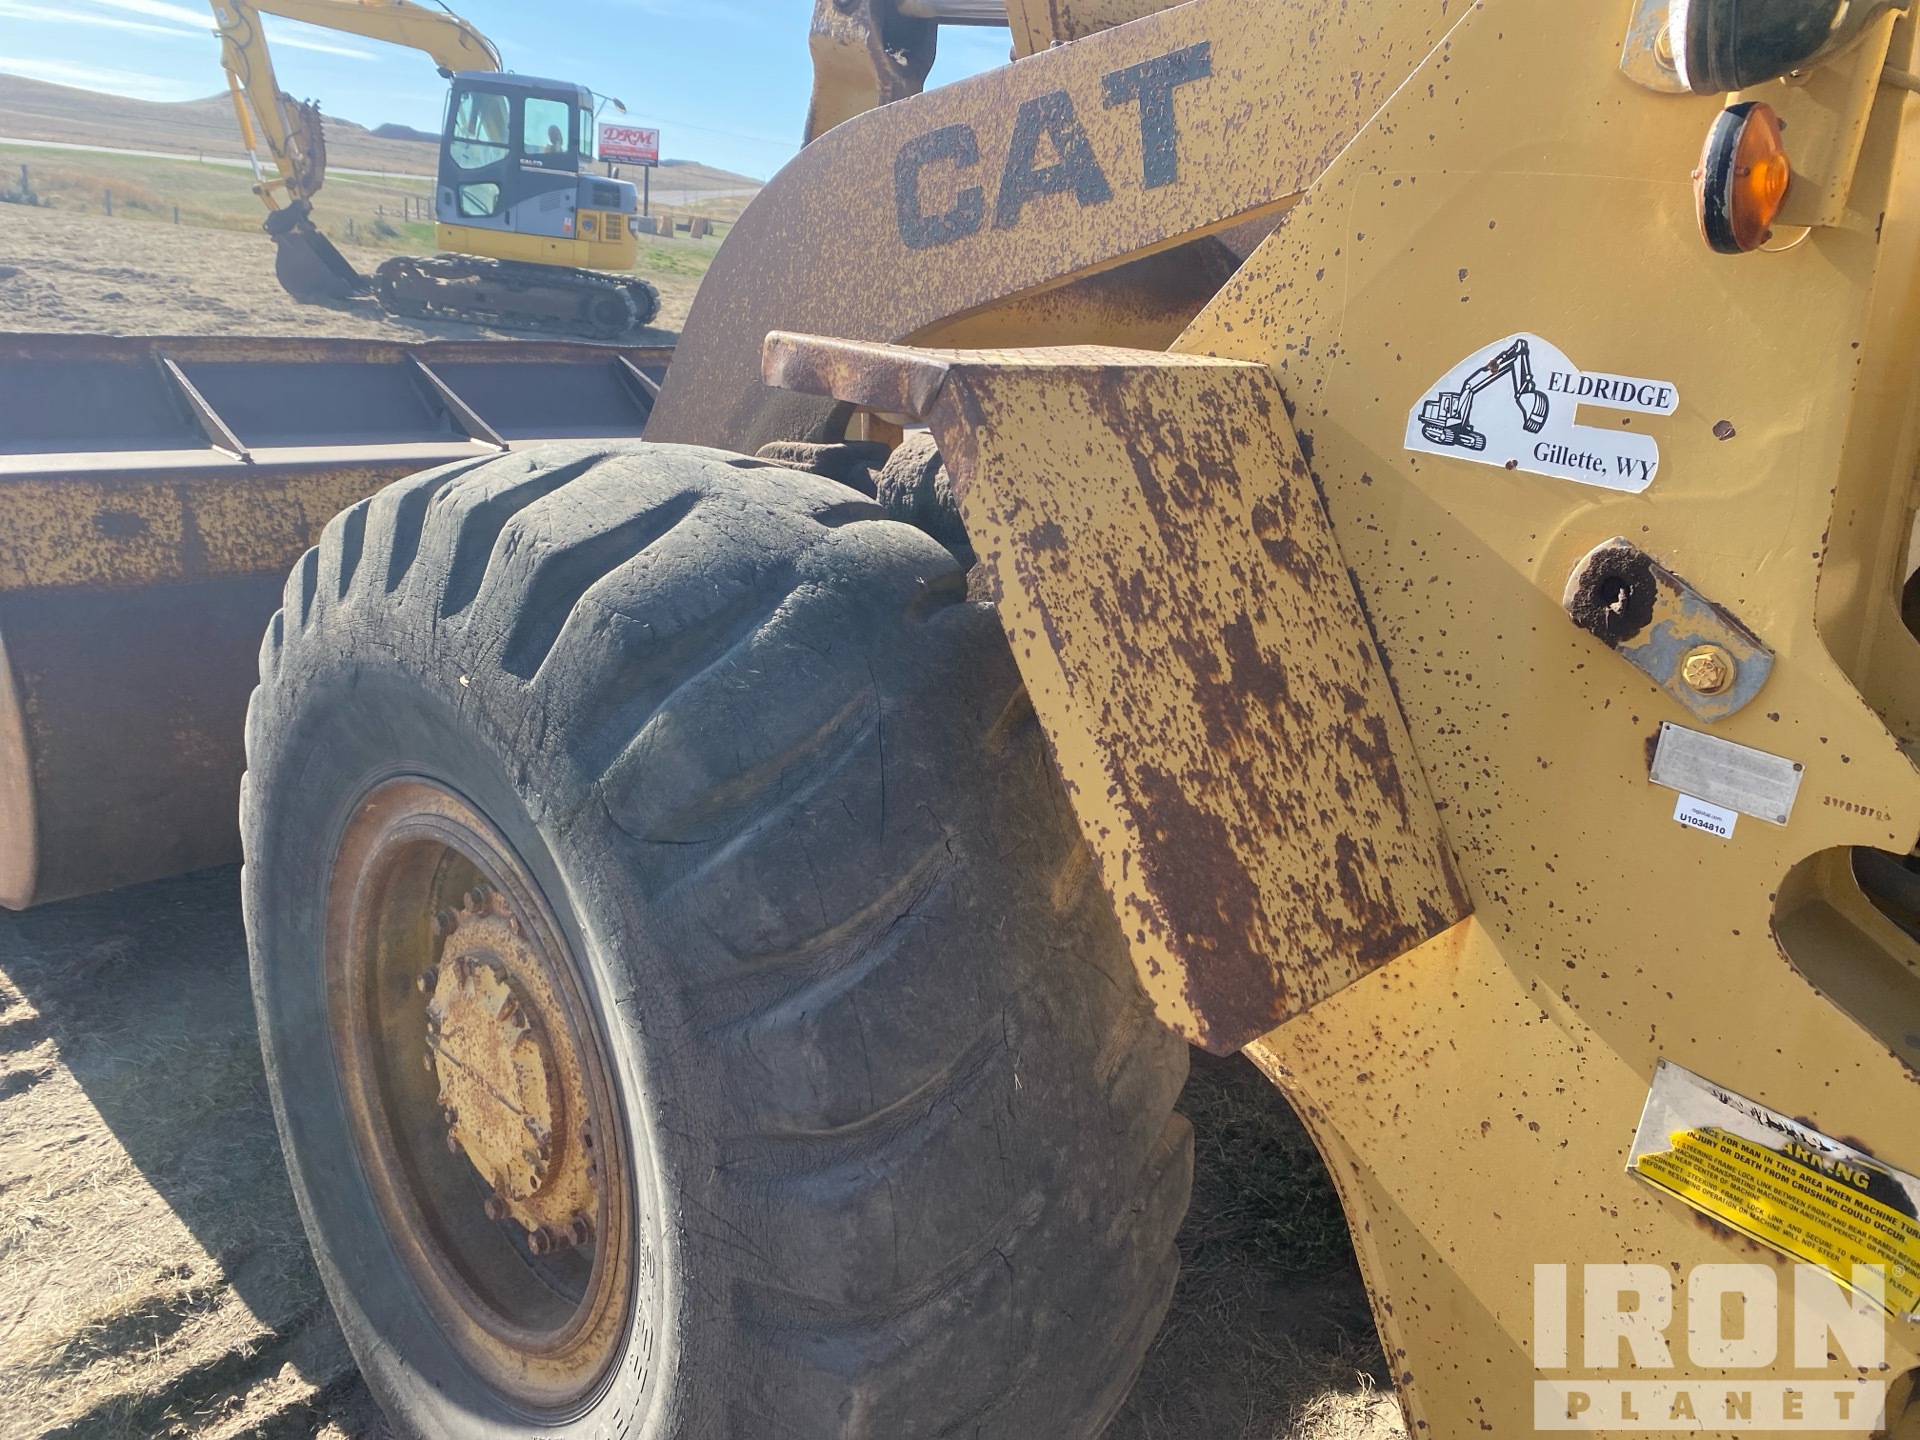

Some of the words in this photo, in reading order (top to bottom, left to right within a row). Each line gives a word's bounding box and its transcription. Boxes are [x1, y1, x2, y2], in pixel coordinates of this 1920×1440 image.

[603, 127, 655, 146] DRM
[894, 39, 1211, 250] CAT
[1547, 371, 1672, 409] ELDRIDGE
[1533, 442, 1607, 477] Gillette,
[1616, 455, 1656, 481] WY
[1680, 813, 1726, 835] U1034810
[1642, 1158, 1665, 1173] BEFORE
[1667, 1169, 1701, 1191] RESUMING
[1702, 1188, 1737, 1210] OPERATION
[1738, 1207, 1748, 1215] OR
[1749, 1212, 1781, 1232] MACHINE
[1783, 1229, 1799, 1242] WILL
[1801, 1238, 1816, 1250] NOT
[1674, 1154, 1692, 1166] NEAR
[1693, 1164, 1719, 1181] CENTER
[1719, 1177, 1728, 1186] OF
[1682, 1142, 1713, 1160] STEERING
[1714, 1157, 1736, 1171] FRAME
[1738, 1169, 1755, 1181] LOCK
[1757, 1179, 1772, 1191] LINK
[1774, 1187, 1806, 1208] BETWEEN
[1808, 1204, 1831, 1219] FRONT
[1831, 1216, 1847, 1228] AND
[1848, 1224, 1867, 1238] REAR
[1868, 1234, 1897, 1255] FRAMES
[1687, 1131, 1718, 1148] INJURY
[1720, 1145, 1732, 1156] OR
[1734, 1151, 1762, 1170] DEATH
[1764, 1166, 1790, 1184] FROM
[1791, 1180, 1838, 1208] CRUSHING
[1840, 1204, 1872, 1224] COULD
[1707, 1162, 1756, 1191] TRANSPORTING
[1756, 1188, 1789, 1208] MACHINE
[1789, 1203, 1799, 1213] ON
[1799, 1209, 1832, 1230] ANOTHER
[1866, 1242, 1877, 1253] OR
[1722, 1135, 1739, 1148] FOR
[1740, 1144, 1761, 1159] MAN
[1763, 1155, 1773, 1165] IN
[1776, 1161, 1797, 1176] THIS
[1799, 1172, 1823, 1189] AREA
[1826, 1185, 1852, 1203] WHEN
[1854, 1199, 1898, 1225] MACHINE
[1781, 1142, 1871, 1190] ARNNG
[1687, 1171, 1717, 1191] STEERING
[1720, 1189, 1744, 1205] FRAME
[1747, 1202, 1765, 1215] LOCK
[1767, 1213, 1784, 1225] LINK
[1787, 1223, 1802, 1234] AND
[1805, 1231, 1834, 1249] SECURE
[1837, 1248, 1847, 1257] TO
[1888, 1277, 1915, 1298] PLATES
